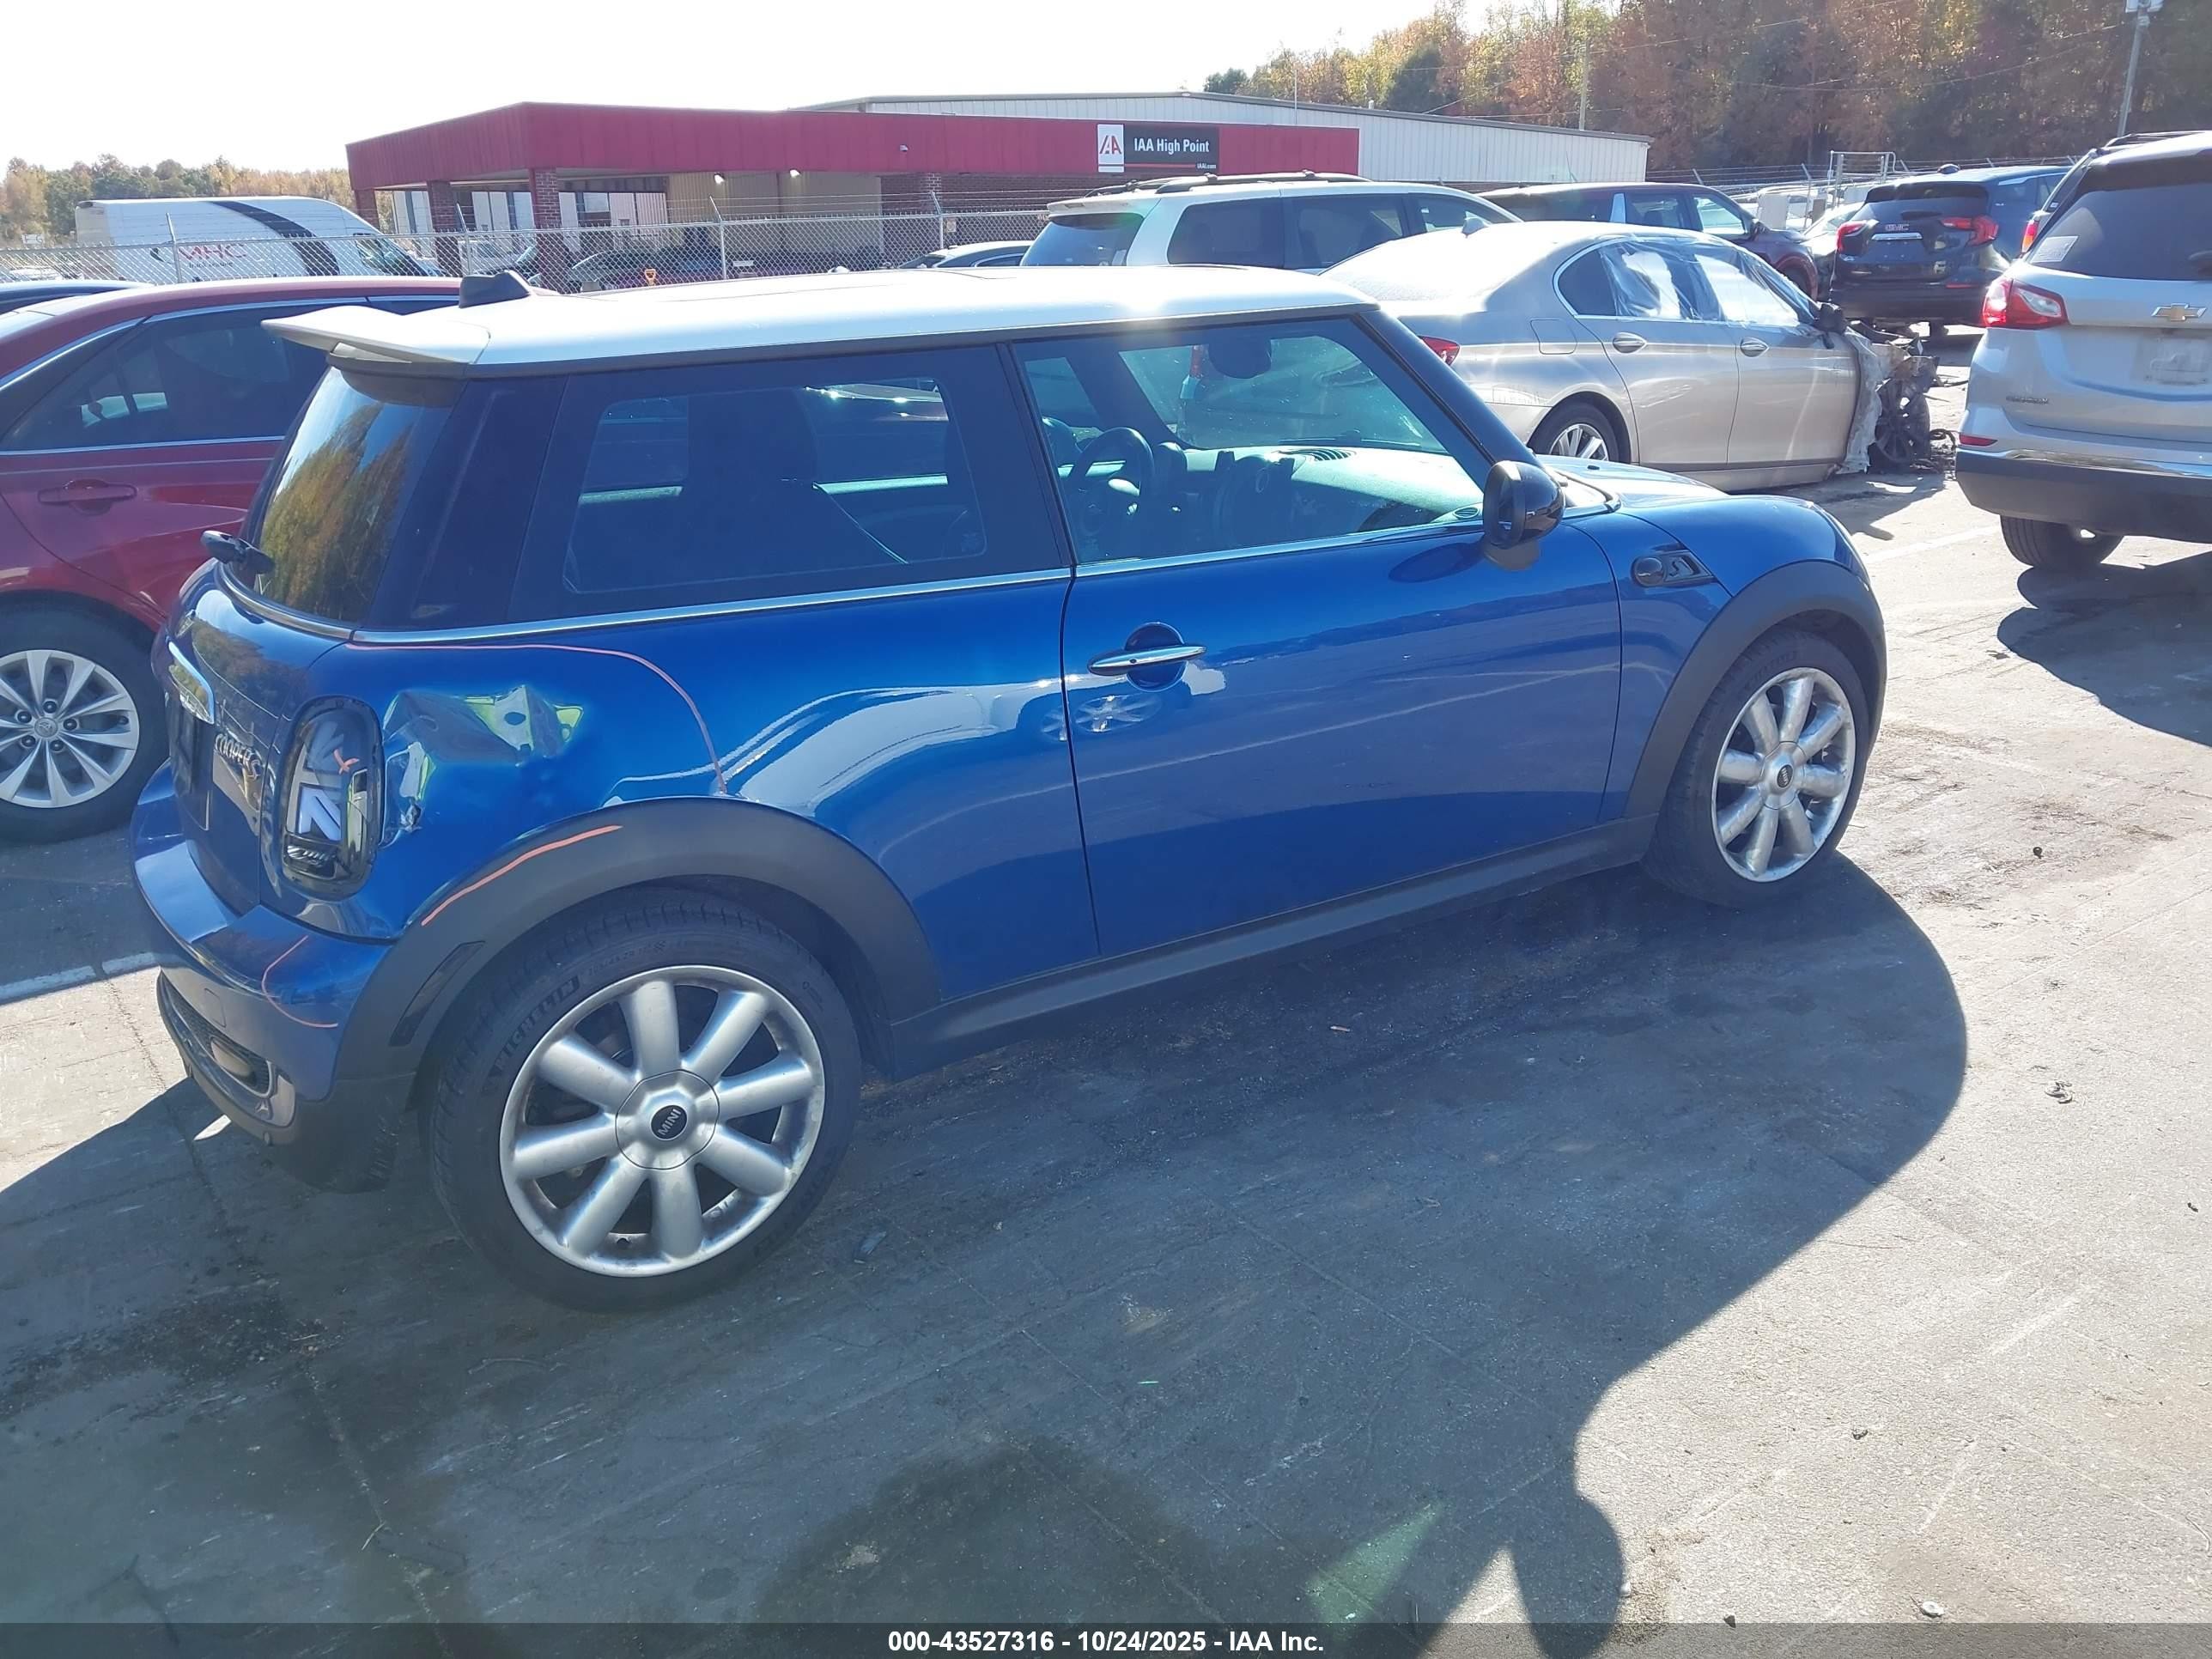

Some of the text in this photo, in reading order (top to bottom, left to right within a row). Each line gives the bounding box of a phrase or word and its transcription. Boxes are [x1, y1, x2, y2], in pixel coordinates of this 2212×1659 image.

[1133, 137, 1210, 155] IAA High Point
[657, 1108, 682, 1136] MINI
